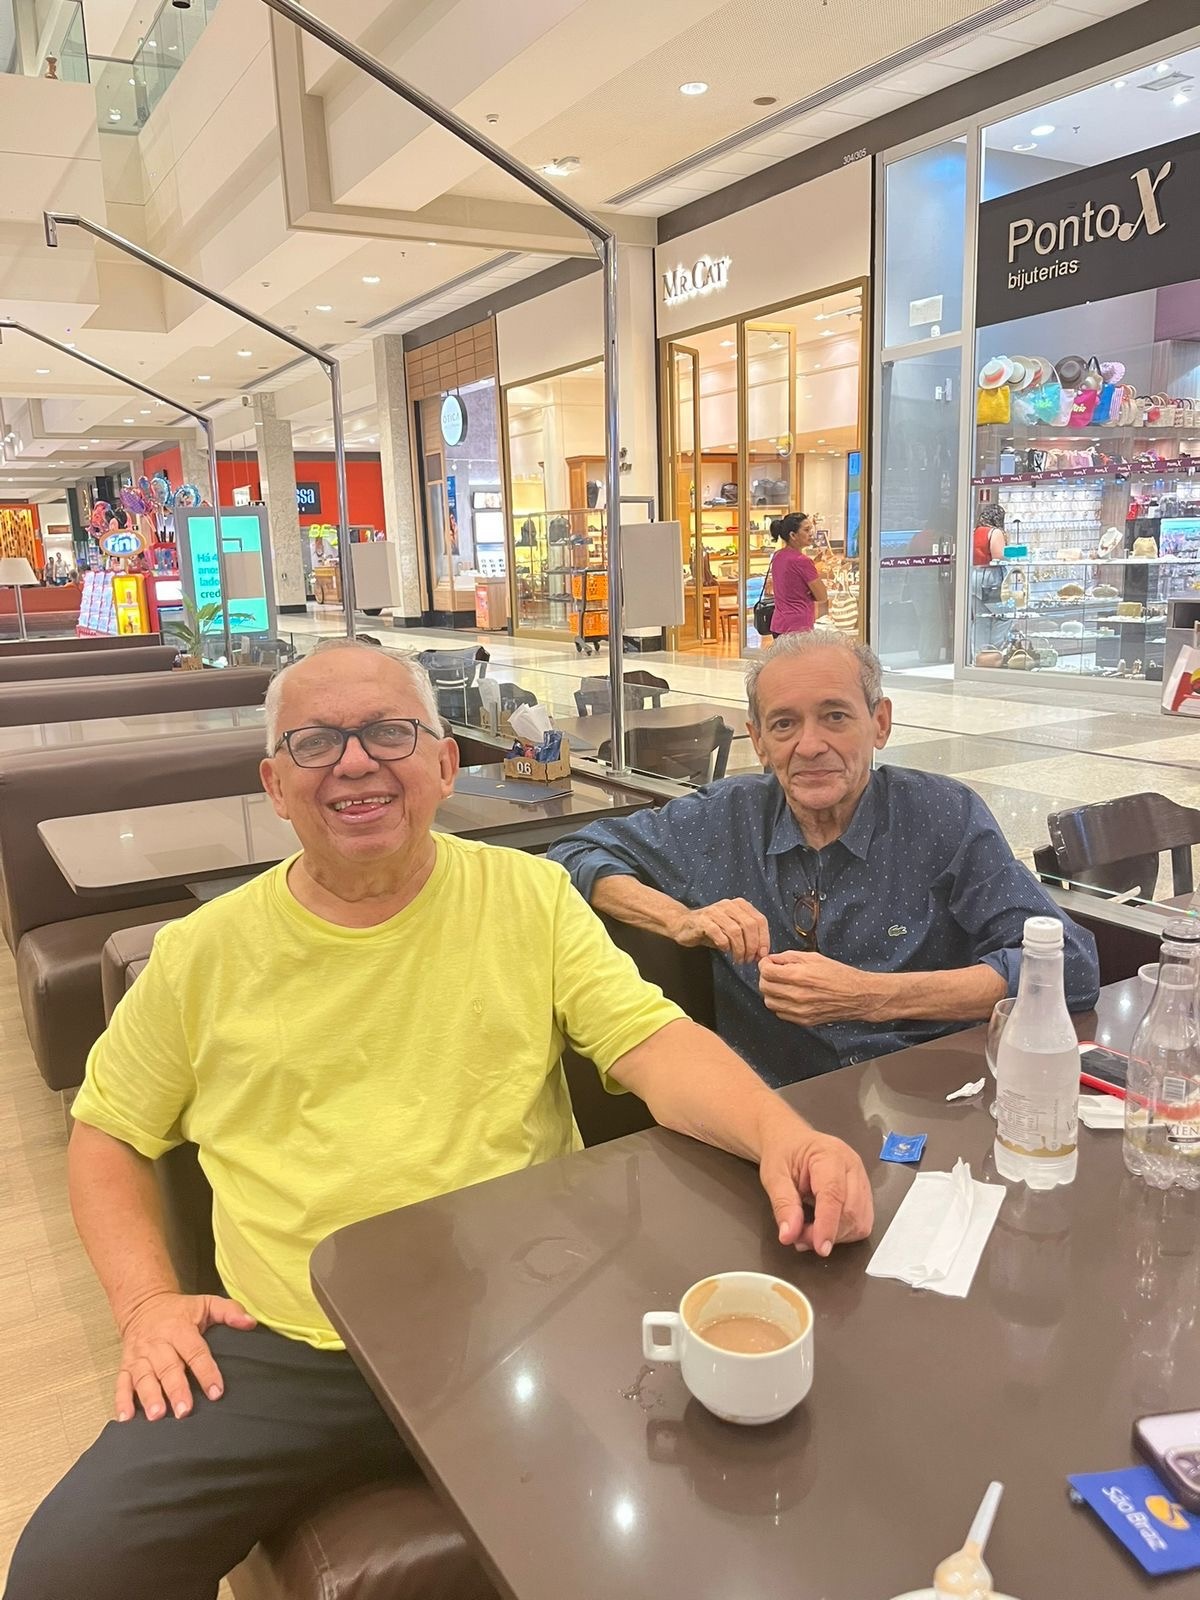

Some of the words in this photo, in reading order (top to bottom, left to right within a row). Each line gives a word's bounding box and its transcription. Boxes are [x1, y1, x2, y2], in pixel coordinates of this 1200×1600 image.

[1008, 259, 1081, 291] bijuterias
[197, 552, 211, 563] Há
[517, 761, 533, 776] 06
[1102, 1486, 1135, 1514] São
